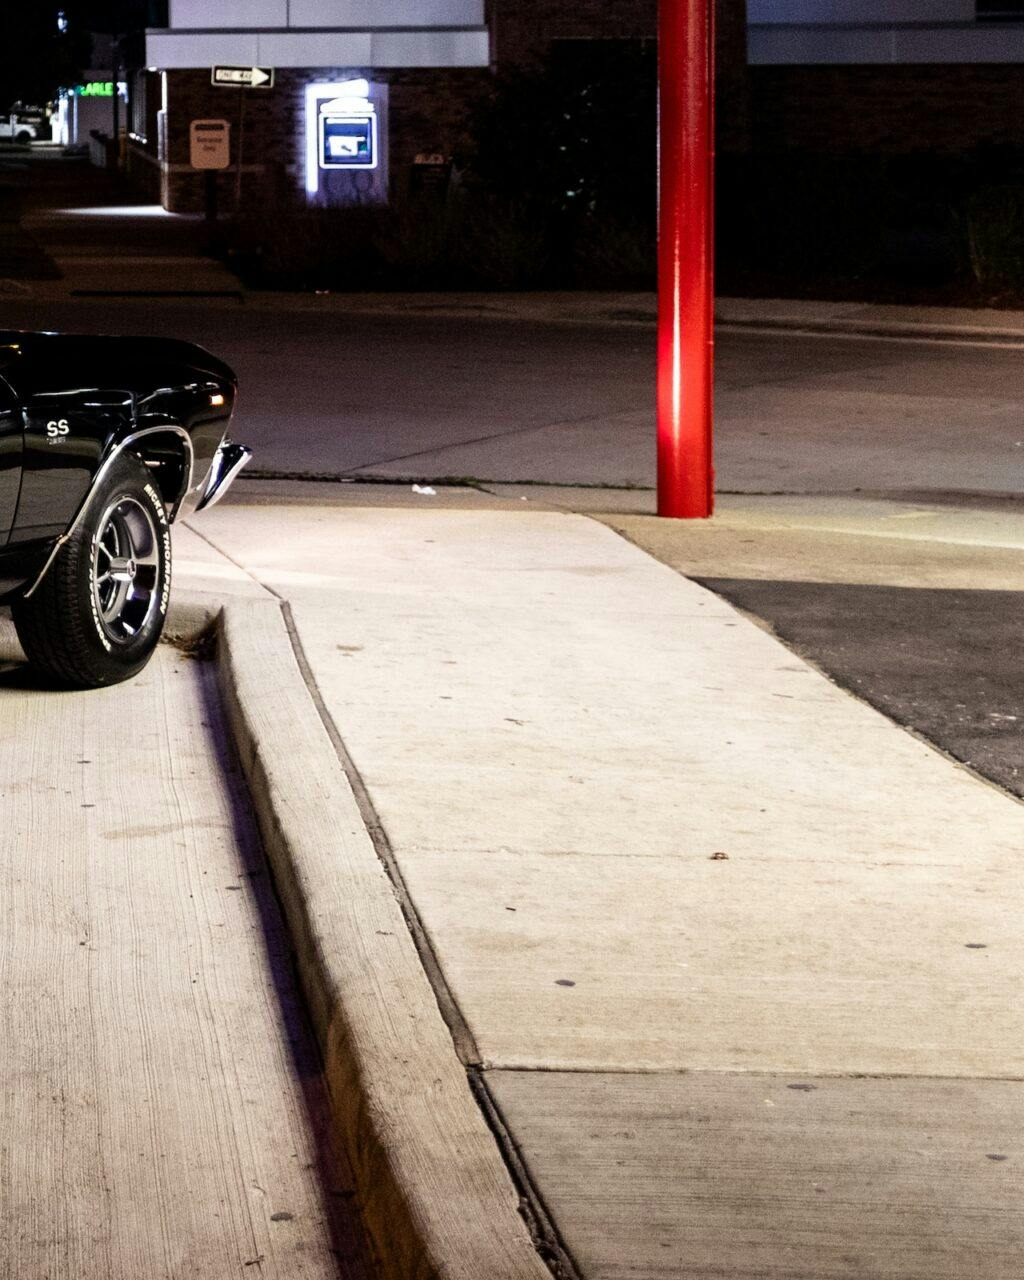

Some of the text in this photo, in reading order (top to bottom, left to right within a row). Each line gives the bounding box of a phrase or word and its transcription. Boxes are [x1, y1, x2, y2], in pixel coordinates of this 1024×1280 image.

[47, 419, 70, 437] SS
[143, 483, 171, 615] MICKEY THOMPSON
